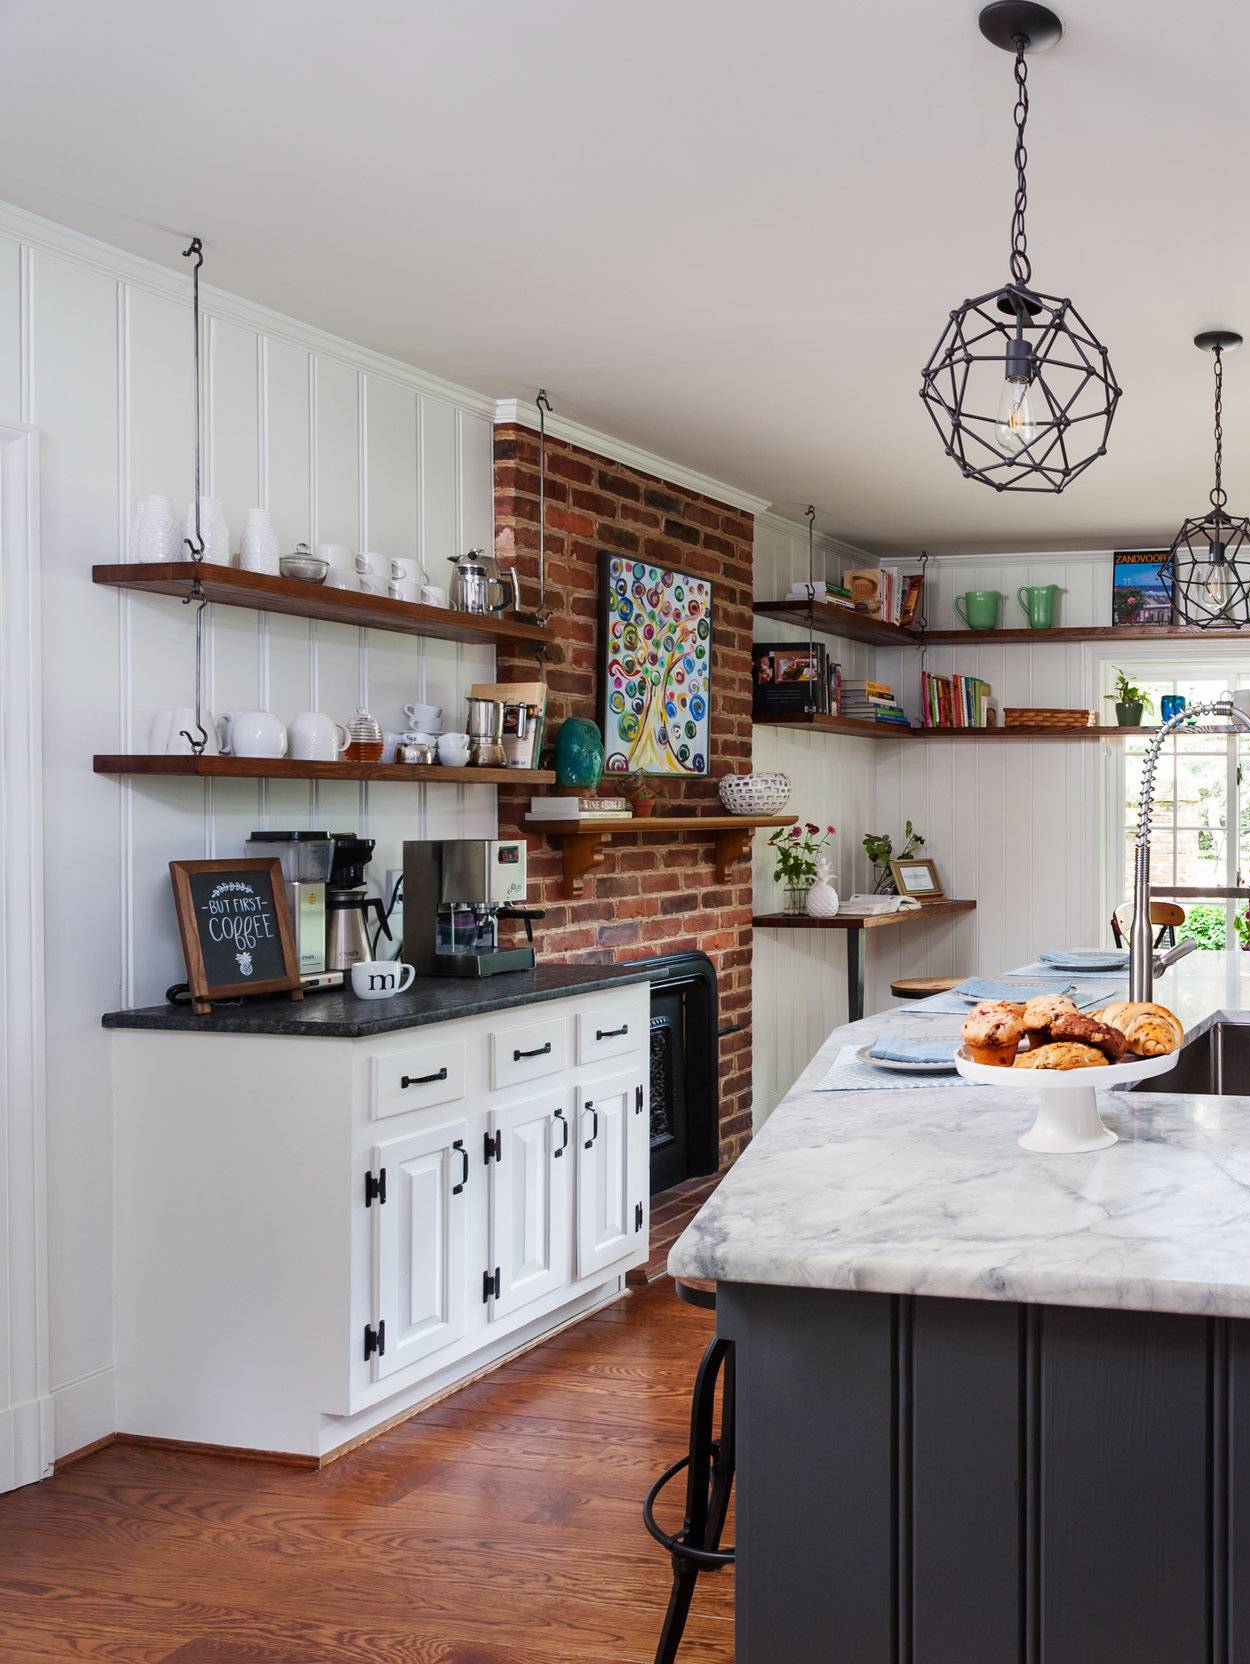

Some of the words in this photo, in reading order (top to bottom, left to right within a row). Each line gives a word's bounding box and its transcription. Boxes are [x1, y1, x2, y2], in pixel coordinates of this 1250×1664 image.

[1115, 553, 1168, 563] ZANDVOOR
[209, 899, 230, 914] BUT
[233, 896, 262, 912] FIRST
[208, 913, 275, 951] COFFEE
[368, 973, 395, 991] m
